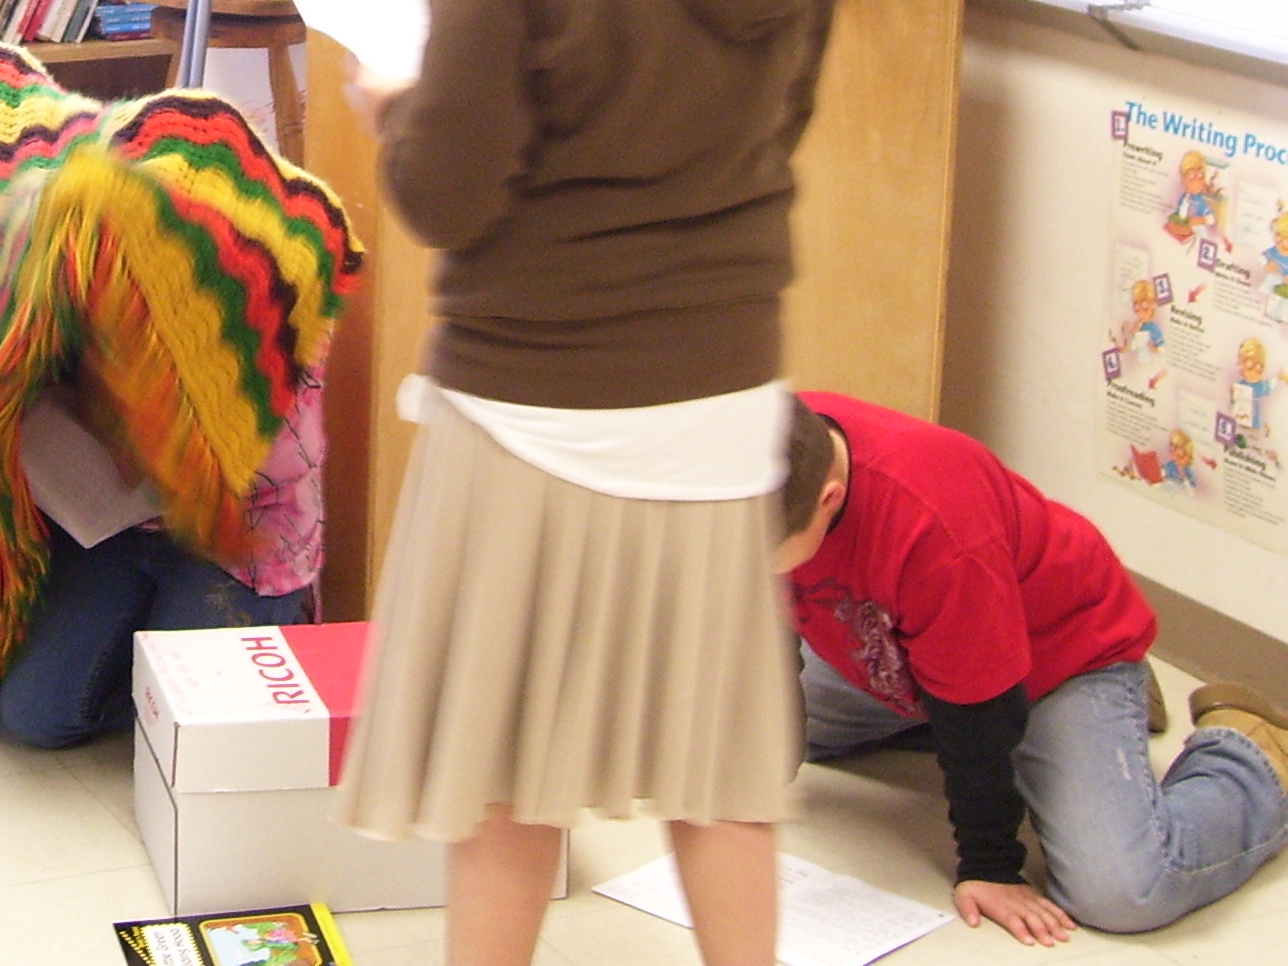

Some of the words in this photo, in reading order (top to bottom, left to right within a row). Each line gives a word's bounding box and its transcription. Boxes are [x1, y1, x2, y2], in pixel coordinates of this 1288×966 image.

[1125, 100, 1159, 129] The
[1162, 110, 1239, 158] Writing
[240, 636, 310, 706] RICOH
